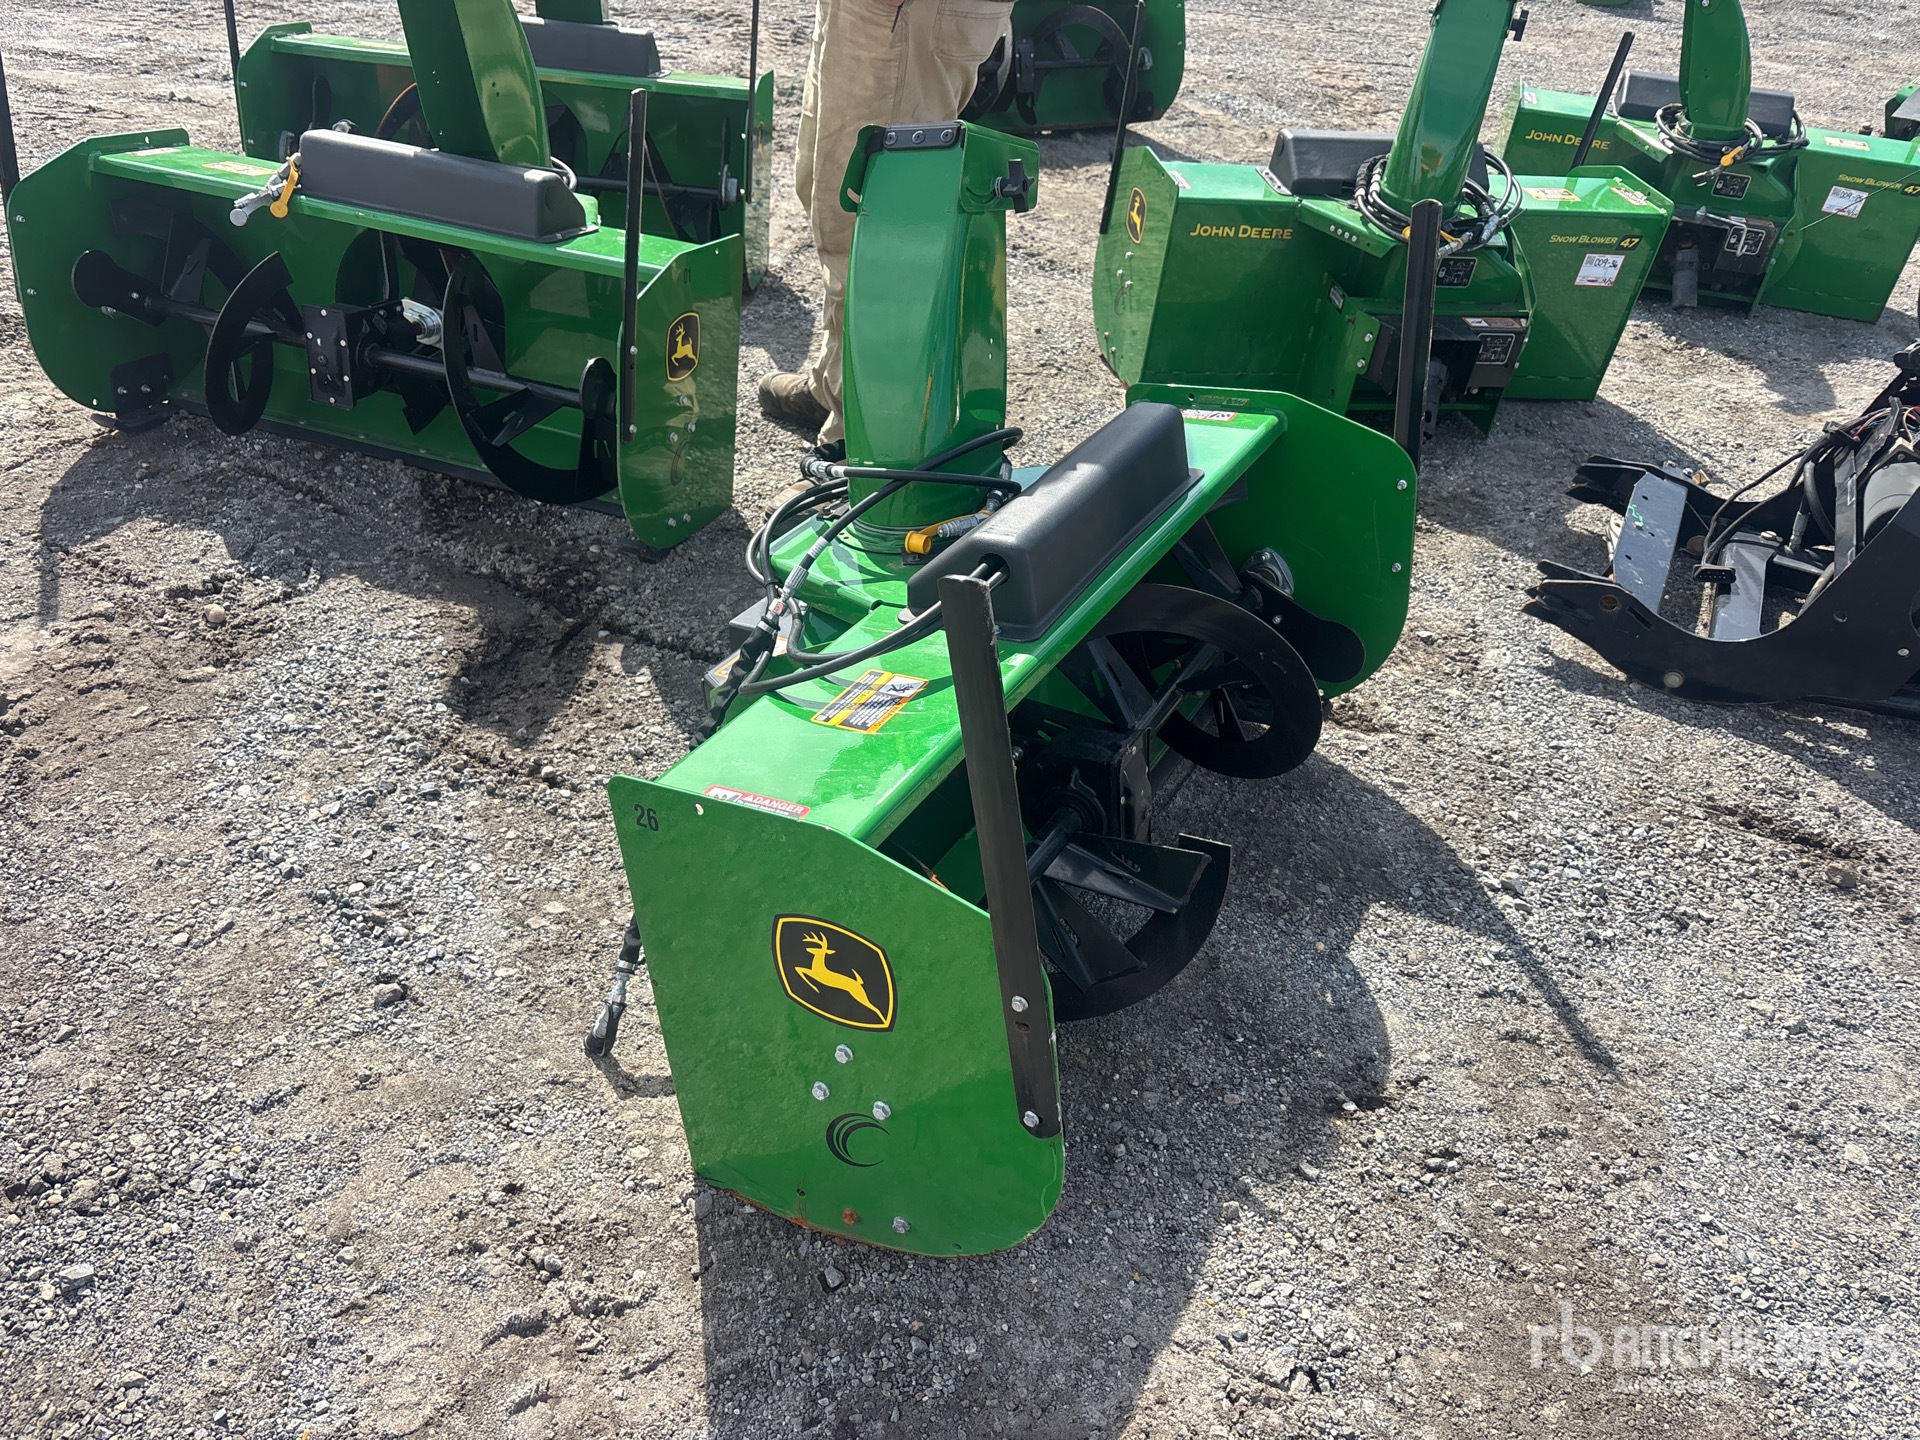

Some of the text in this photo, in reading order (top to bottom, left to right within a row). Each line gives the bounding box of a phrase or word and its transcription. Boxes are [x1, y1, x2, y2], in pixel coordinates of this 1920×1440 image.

[1525, 129, 1610, 150] JOHN DERE
[1838, 173, 1920, 195] SNOW BLOWER 47
[1189, 223, 1294, 239] JOHN DEERE
[1548, 234, 1579, 243] SNOW
[1578, 234, 1618, 244] BLOWER
[1619, 237, 1640, 248] 47
[753, 796, 804, 814] DANGER
[633, 803, 659, 832] 26
